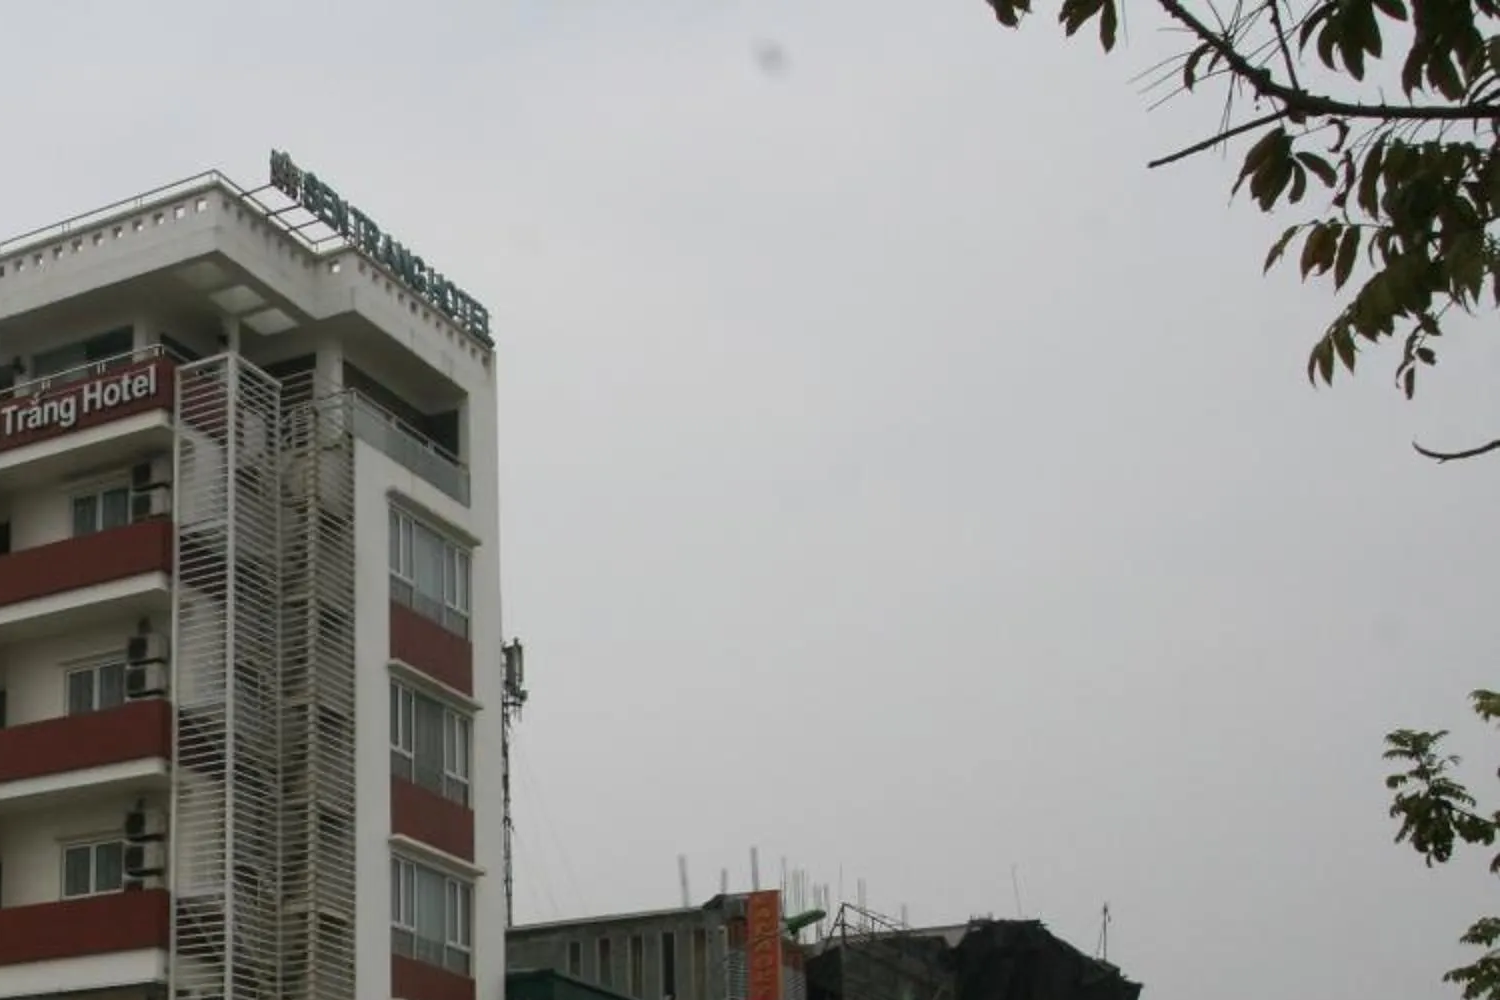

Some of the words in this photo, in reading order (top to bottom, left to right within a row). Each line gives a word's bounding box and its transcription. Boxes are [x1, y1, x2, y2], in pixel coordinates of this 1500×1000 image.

[302, 171, 349, 236] SEN
[426, 267, 494, 346] HOTEL
[0, 391, 78, 435] Trắng
[82, 364, 157, 413] Hotel
